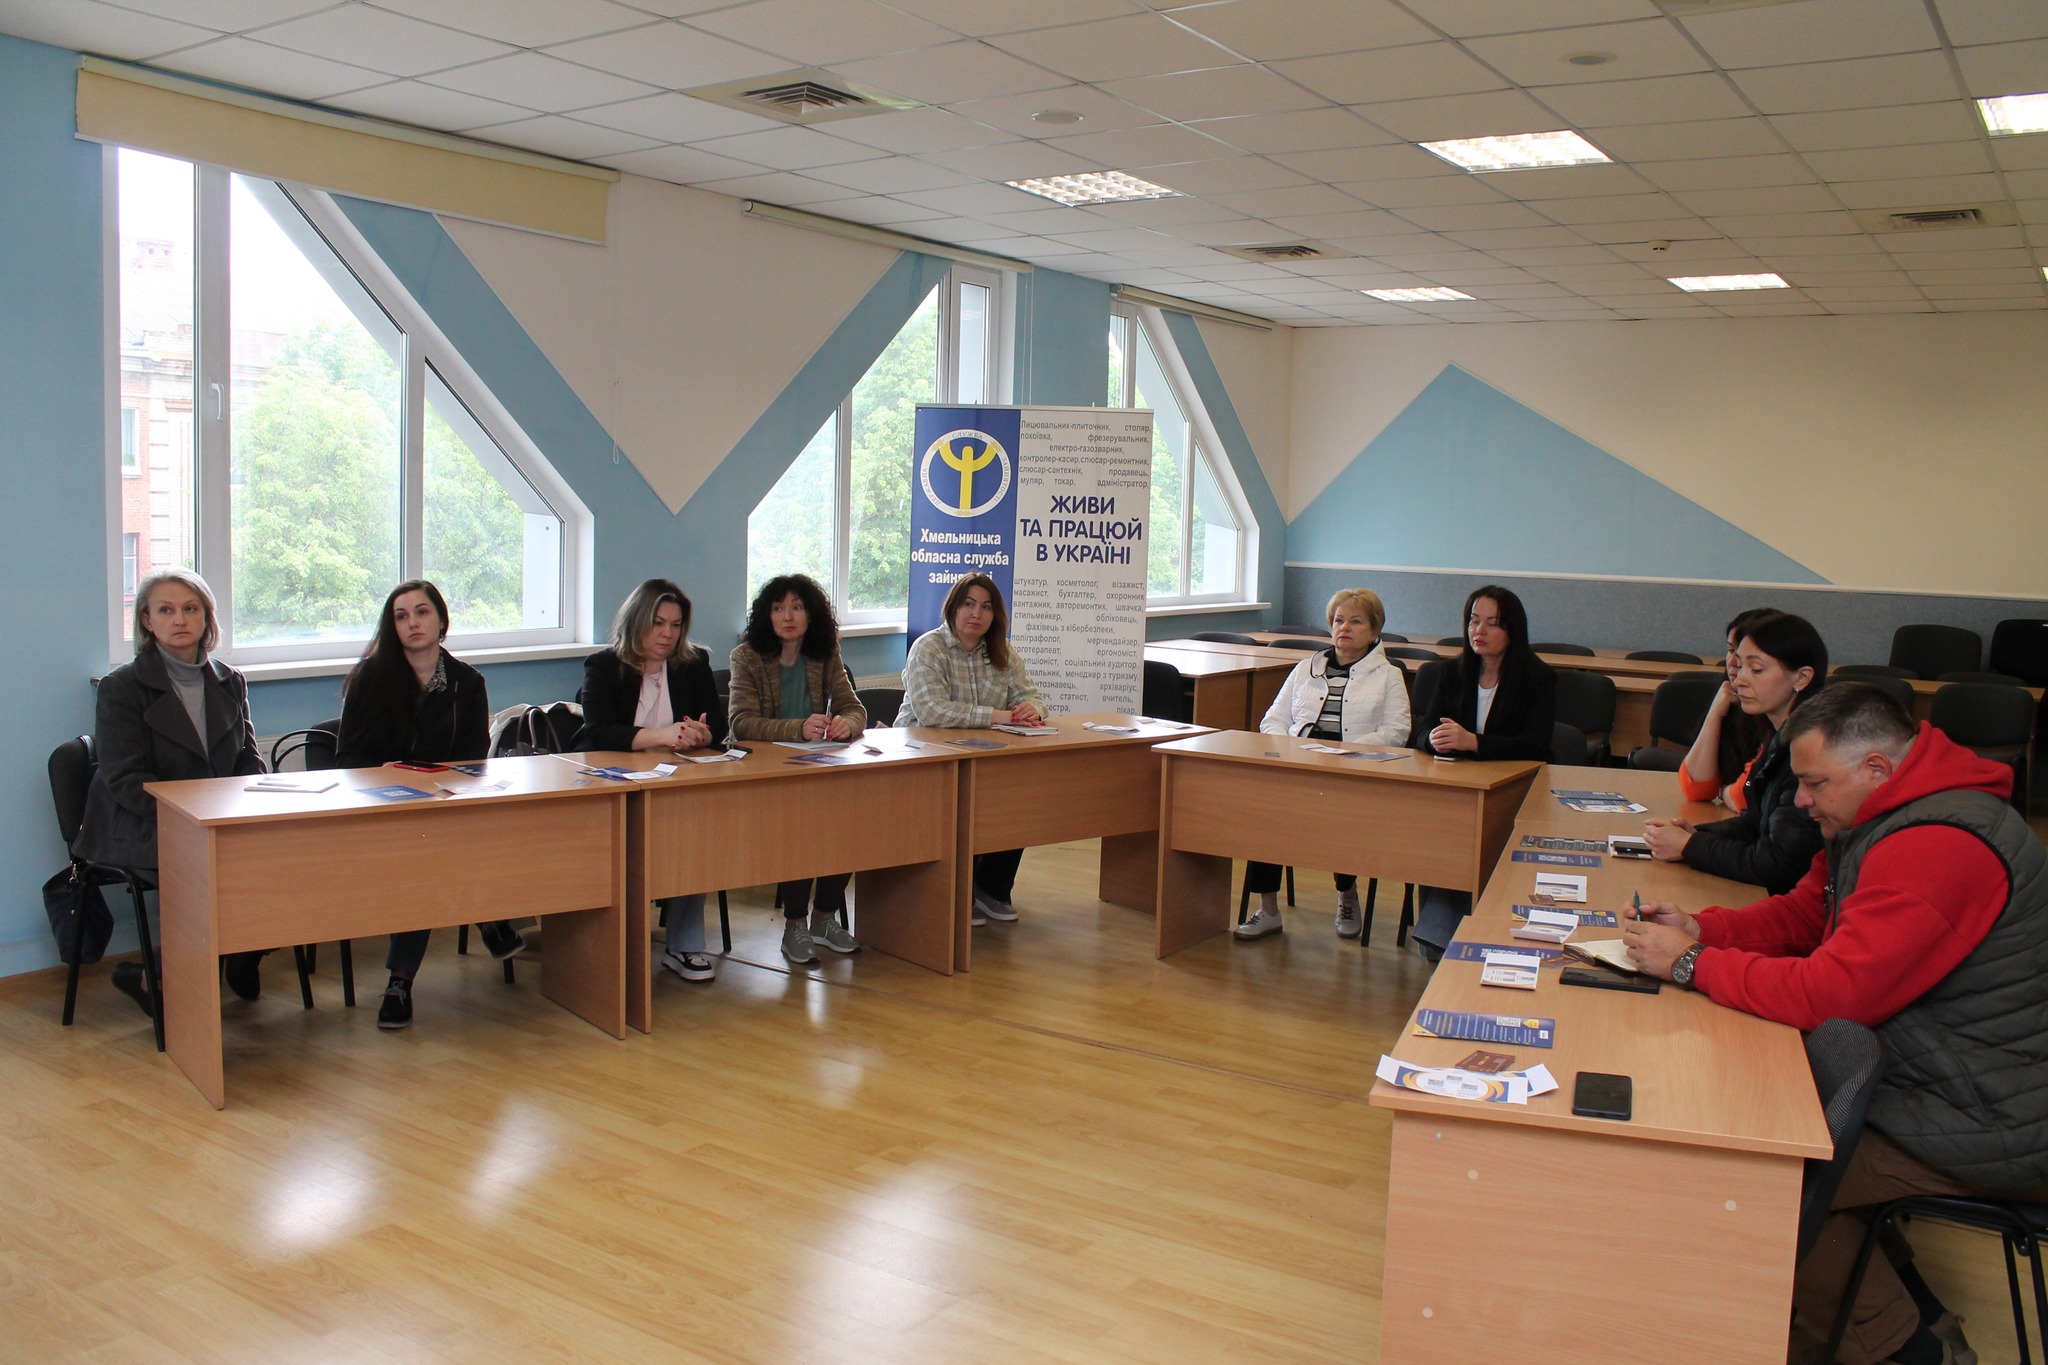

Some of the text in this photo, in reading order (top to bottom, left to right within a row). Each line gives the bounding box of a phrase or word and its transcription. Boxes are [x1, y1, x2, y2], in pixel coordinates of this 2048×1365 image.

[952, 432, 983, 440] СЛУЖБА
[1020, 432, 1150, 444] покоївка, фрезерувальник,
[1049, 444, 1124, 454] електро-газозварник,
[1019, 466, 1150, 478] слюсар-сантехнік, продавець,
[1054, 478, 1076, 486] токар,
[1050, 495, 1115, 515] ЖИВИ
[1020, 517, 1142, 543] ТА ПРАЦЮЙ
[920, 528, 1002, 547] Хмельницька
[1036, 542, 1131, 564] В УКРАЇНІ
[911, 549, 1010, 568] обласна служба
[1014, 578, 1048, 587] штукатур,
[1056, 580, 1098, 588] косметолог,
[1014, 590, 1048, 598] масажист,
[1058, 590, 1096, 600] бухгалтер,
[1026, 622, 1059, 632] фахівець
[1065, 670, 1101, 680] менеджер
[1046, 704, 1070, 712] естра,
